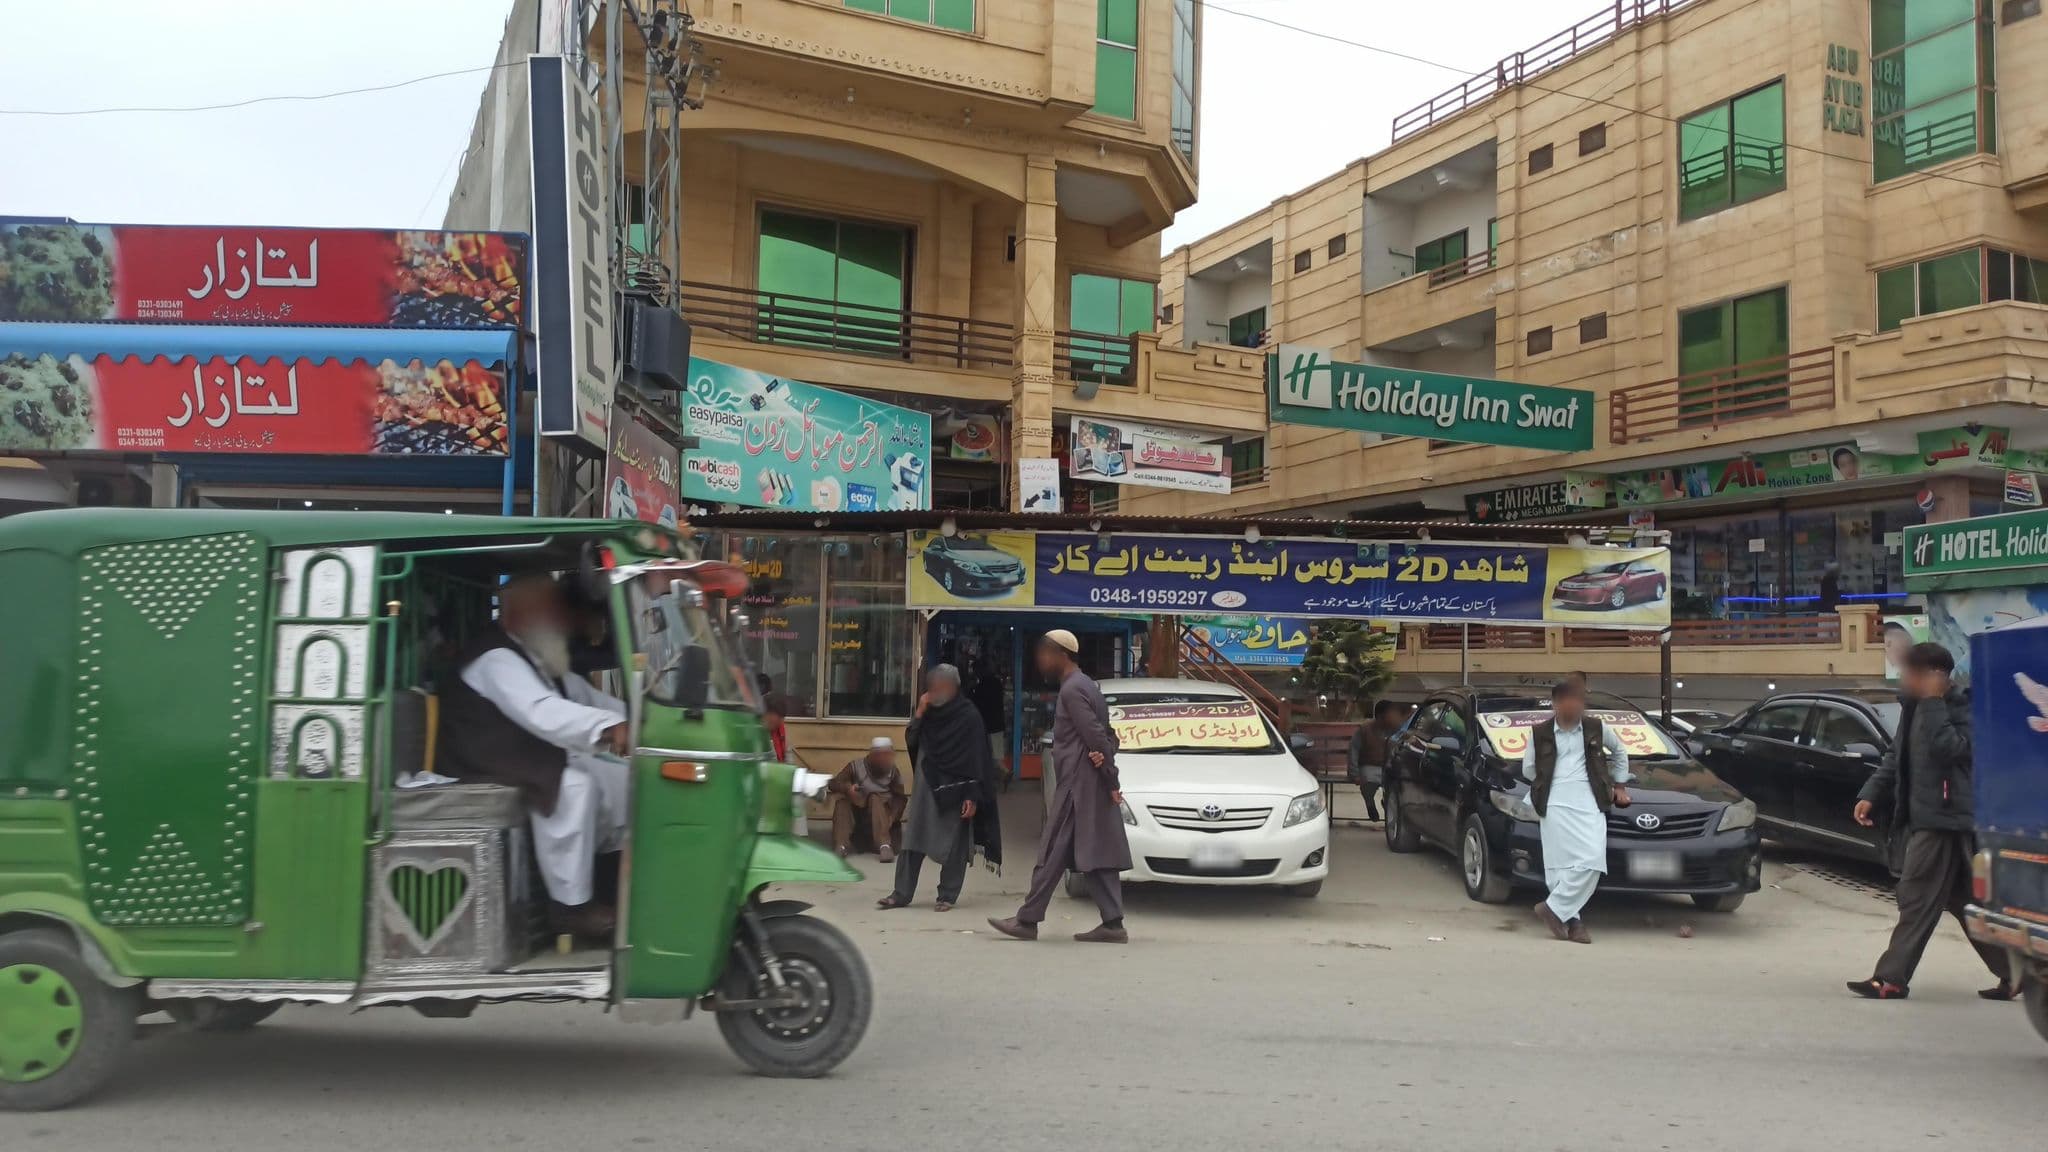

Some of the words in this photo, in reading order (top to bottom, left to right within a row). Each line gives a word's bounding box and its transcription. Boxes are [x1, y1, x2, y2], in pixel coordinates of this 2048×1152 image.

[1826, 42, 1858, 75] ABU
[1824, 76, 1863, 108] AYUB
[1823, 103, 1865, 137] PLAZA
[574, 93, 606, 385] HOTEL
[187, 236, 319, 300] لتازار
[137, 300, 184, 309] 0331-0303491
[137, 309, 184, 319] 0349-1303491
[167, 364, 299, 428] لتازار
[1337, 371, 1459, 427] Holiday
[1463, 384, 1510, 423] Inn
[1516, 394, 1579, 430] Swat
[689, 406, 743, 427] easypaisa
[117, 428, 164, 437] 0331-0303491
[118, 437, 165, 447] 0349-1303491
[744, 415, 785, 456] زون
[658, 455, 670, 484] 2D
[688, 459, 739, 476] mobicash
[1714, 458, 1767, 493] Ali
[1768, 476, 1802, 488] Mobile
[1806, 473, 1832, 485] Zone
[850, 493, 873, 508] easy
[1495, 482, 1567, 511] EMIRATES
[1521, 508, 1544, 518] MEGA
[1545, 504, 1567, 516] MART
[1941, 529, 2001, 562] HOTEL
[1048, 543, 1091, 575] کار
[1144, 547, 1221, 581] رینٹ
[1229, 542, 1288, 582] اینڈ
[1294, 553, 1390, 585] سروس
[1395, 556, 1448, 583] 2D
[1090, 588, 1208, 606] 0348-1959297
[1303, 597, 1322, 610] ہے
[1322, 598, 1350, 611] موجود
[1348, 597, 1381, 611] سہولت
[1400, 595, 1429, 612] شہروں
[1428, 596, 1446, 614] تمام
[1445, 597, 1462, 610] کے
[1462, 598, 1497, 616] پاکستان
[1207, 706, 1229, 715] 2D
[1137, 725, 1182, 745] اسلام
[1190, 722, 1260, 743] راولپنڈی
